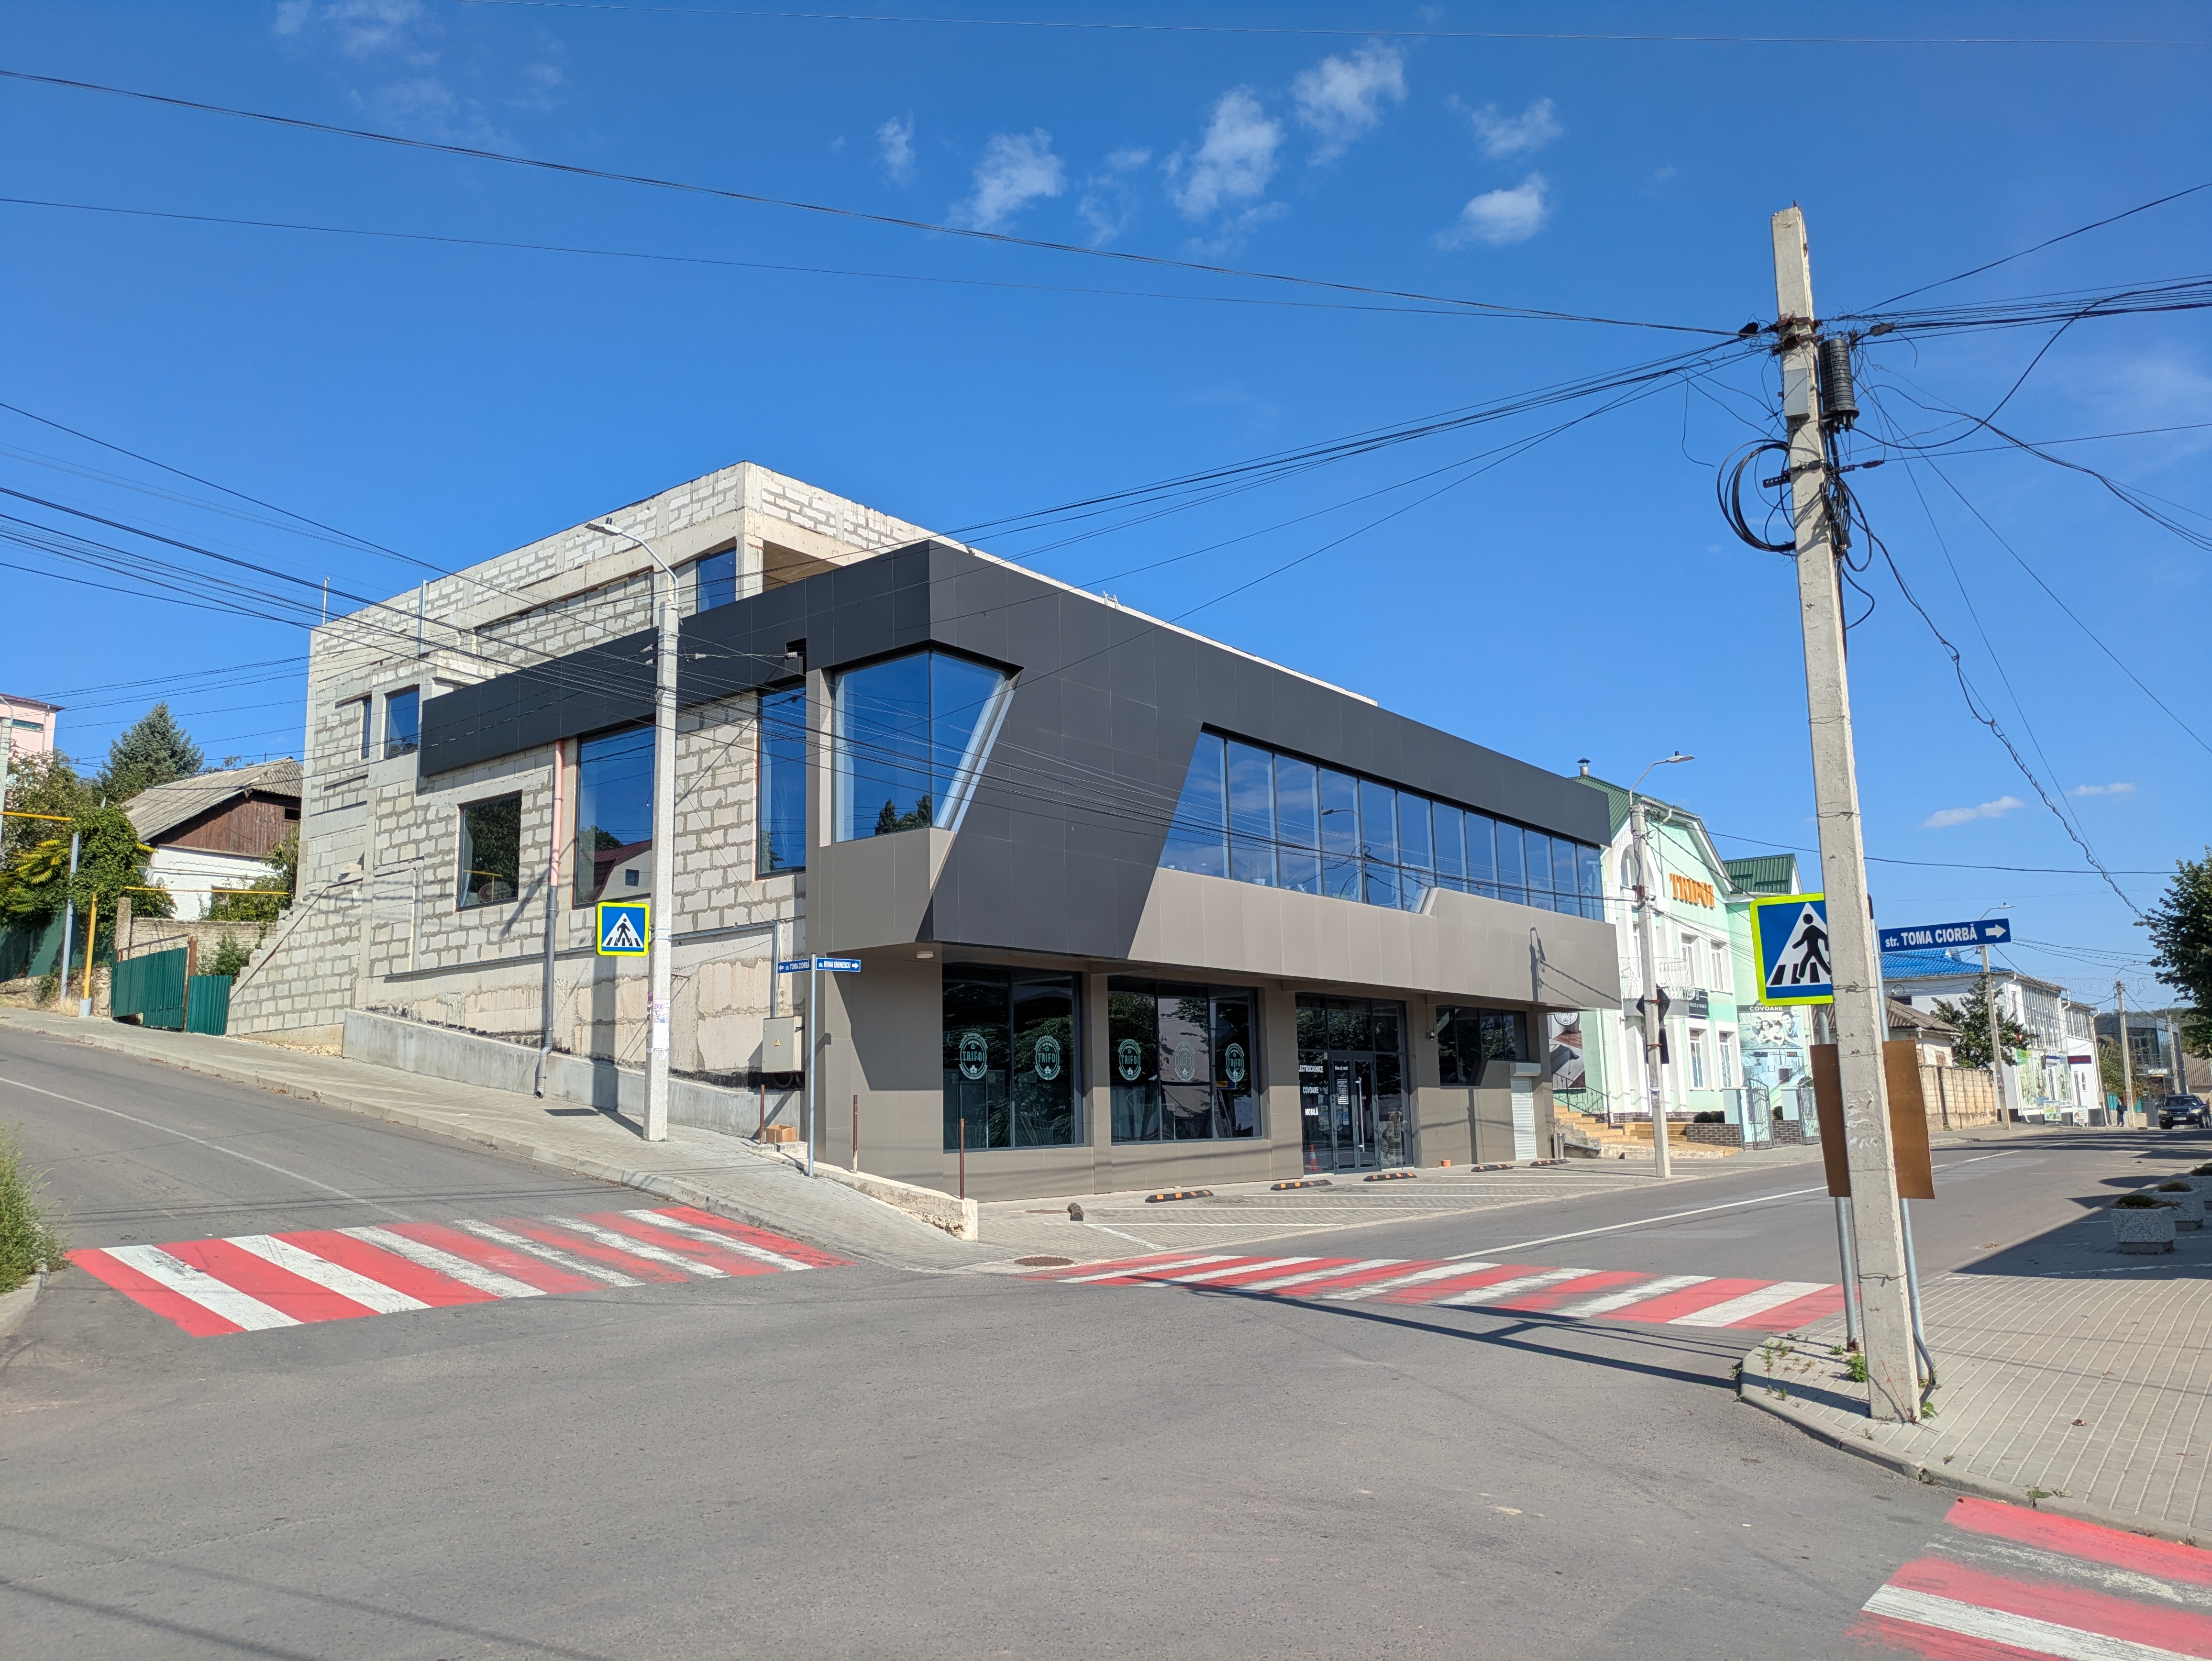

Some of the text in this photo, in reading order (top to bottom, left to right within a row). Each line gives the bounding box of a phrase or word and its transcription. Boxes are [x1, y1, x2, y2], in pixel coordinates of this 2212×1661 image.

[1669, 873, 1715, 908] TRIFOI
[1885, 923, 1978, 947] str. TOMA CIORBĂ
[962, 1051, 984, 1062] TRIFOI
[1037, 1053, 1058, 1063] TRIFOI
[1121, 1055, 1139, 1065] TRIFOI
[1177, 1056, 1193, 1065] TRIFOI
[1227, 1058, 1243, 1067] TRIFOI
[1303, 1086, 1319, 1094] COVOARE
[1305, 1107, 1319, 1116] MOBILĂ
